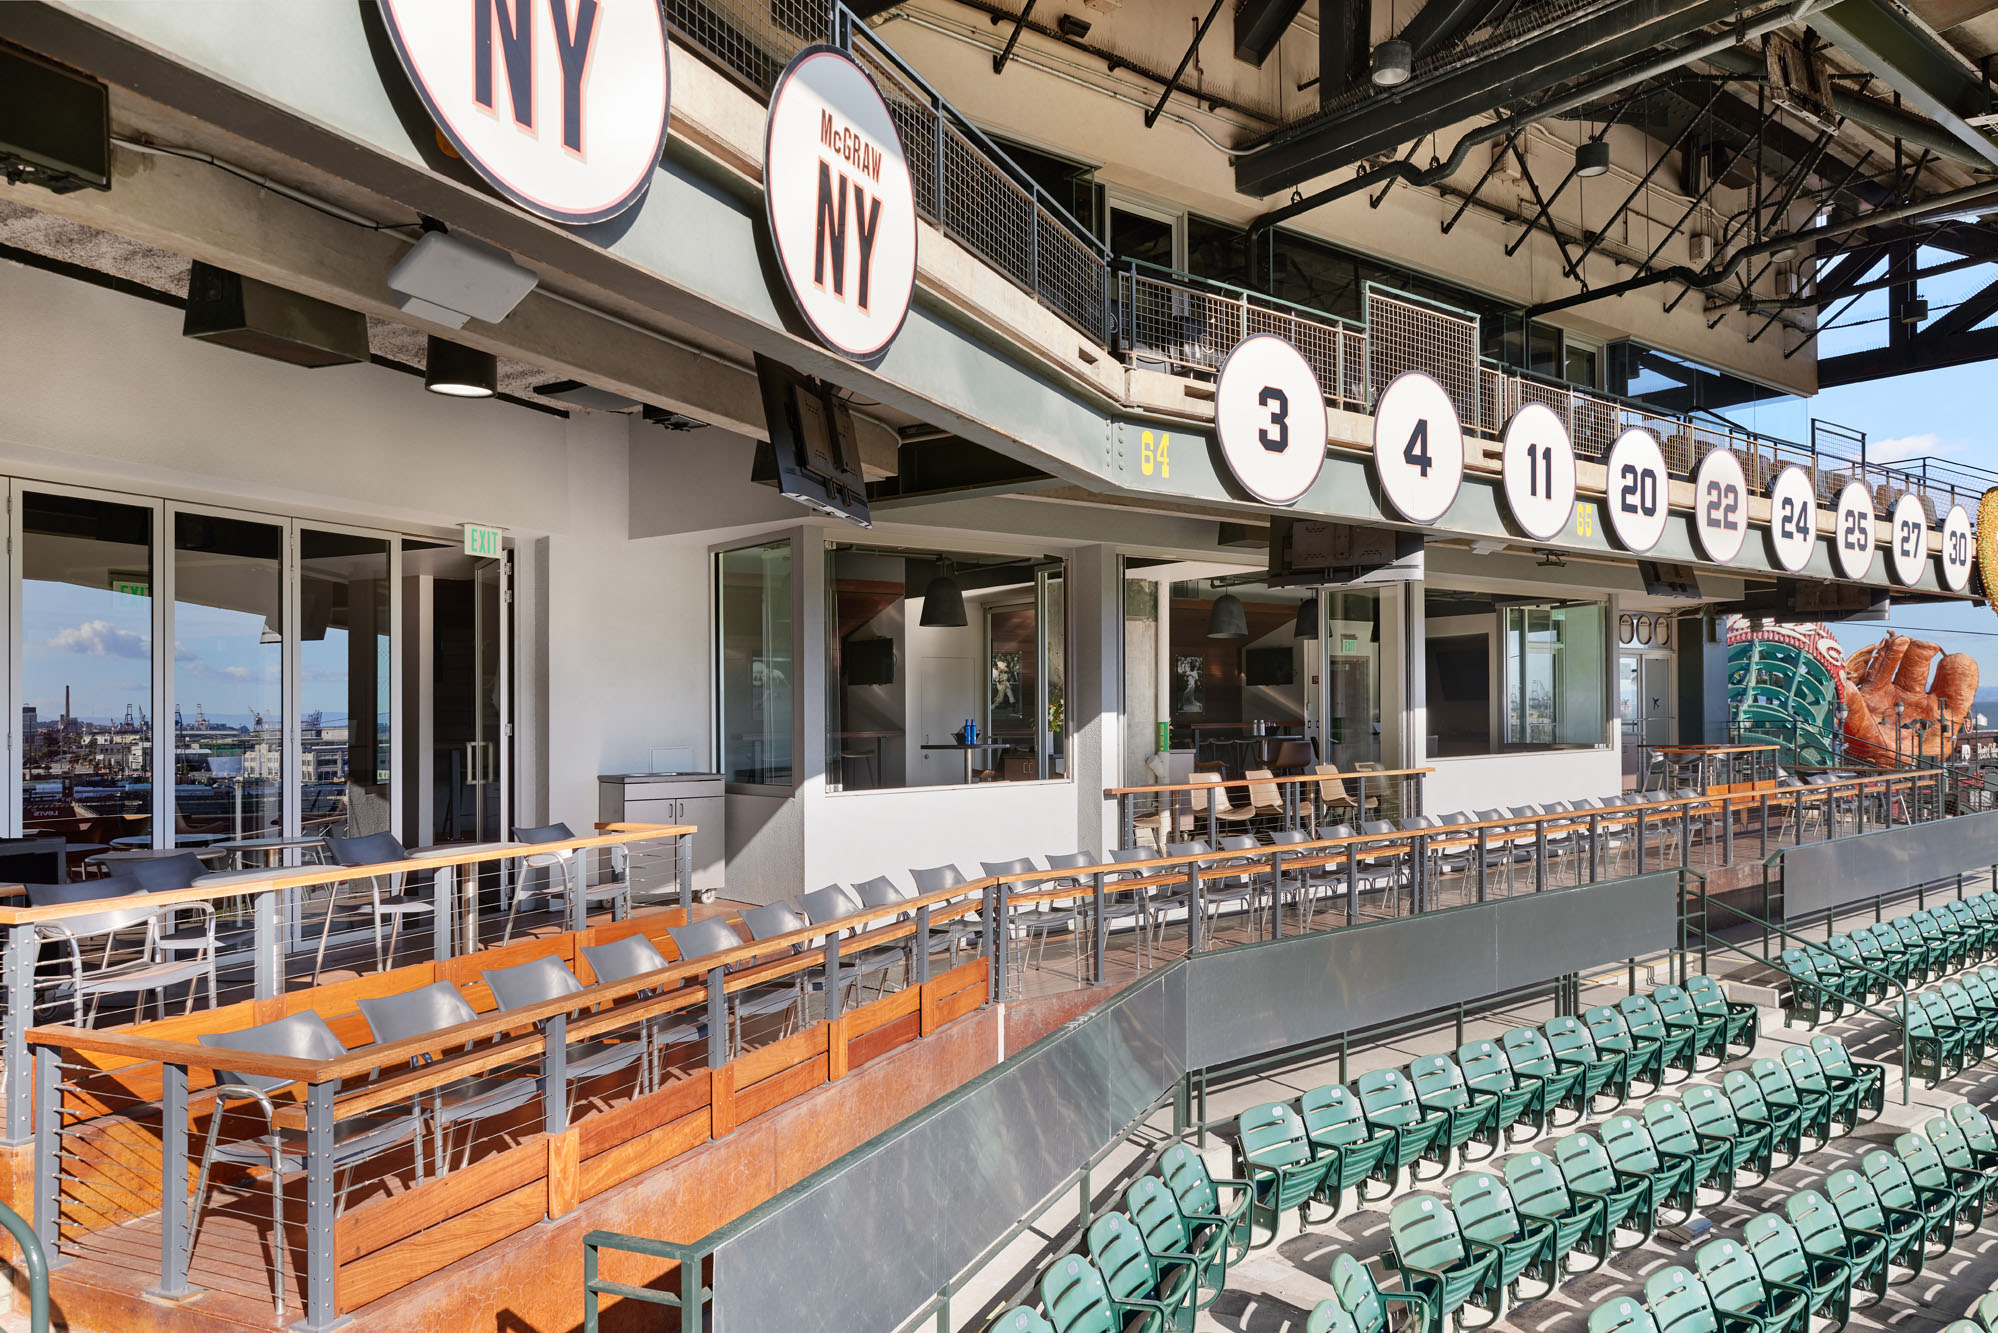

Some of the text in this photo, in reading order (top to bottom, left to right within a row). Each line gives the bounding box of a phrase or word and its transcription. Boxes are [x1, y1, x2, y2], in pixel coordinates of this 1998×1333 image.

[472, 0, 599, 158] NY
[819, 107, 883, 184] McGRAW
[813, 157, 884, 314] NY
[1258, 386, 1289, 454] 3
[1141, 430, 1171, 479] 64
[1403, 418, 1433, 478] 4
[1527, 443, 1552, 500] 11
[1621, 464, 1657, 517] 20
[1706, 480, 1739, 531] 22
[471, 528, 499, 555] EXIT
[1576, 503, 1592, 538] 65
[1781, 497, 1810, 542] 24
[1844, 509, 1868, 552] 25
[1900, 520, 1921, 559] 27
[1949, 530, 1967, 566] 30
